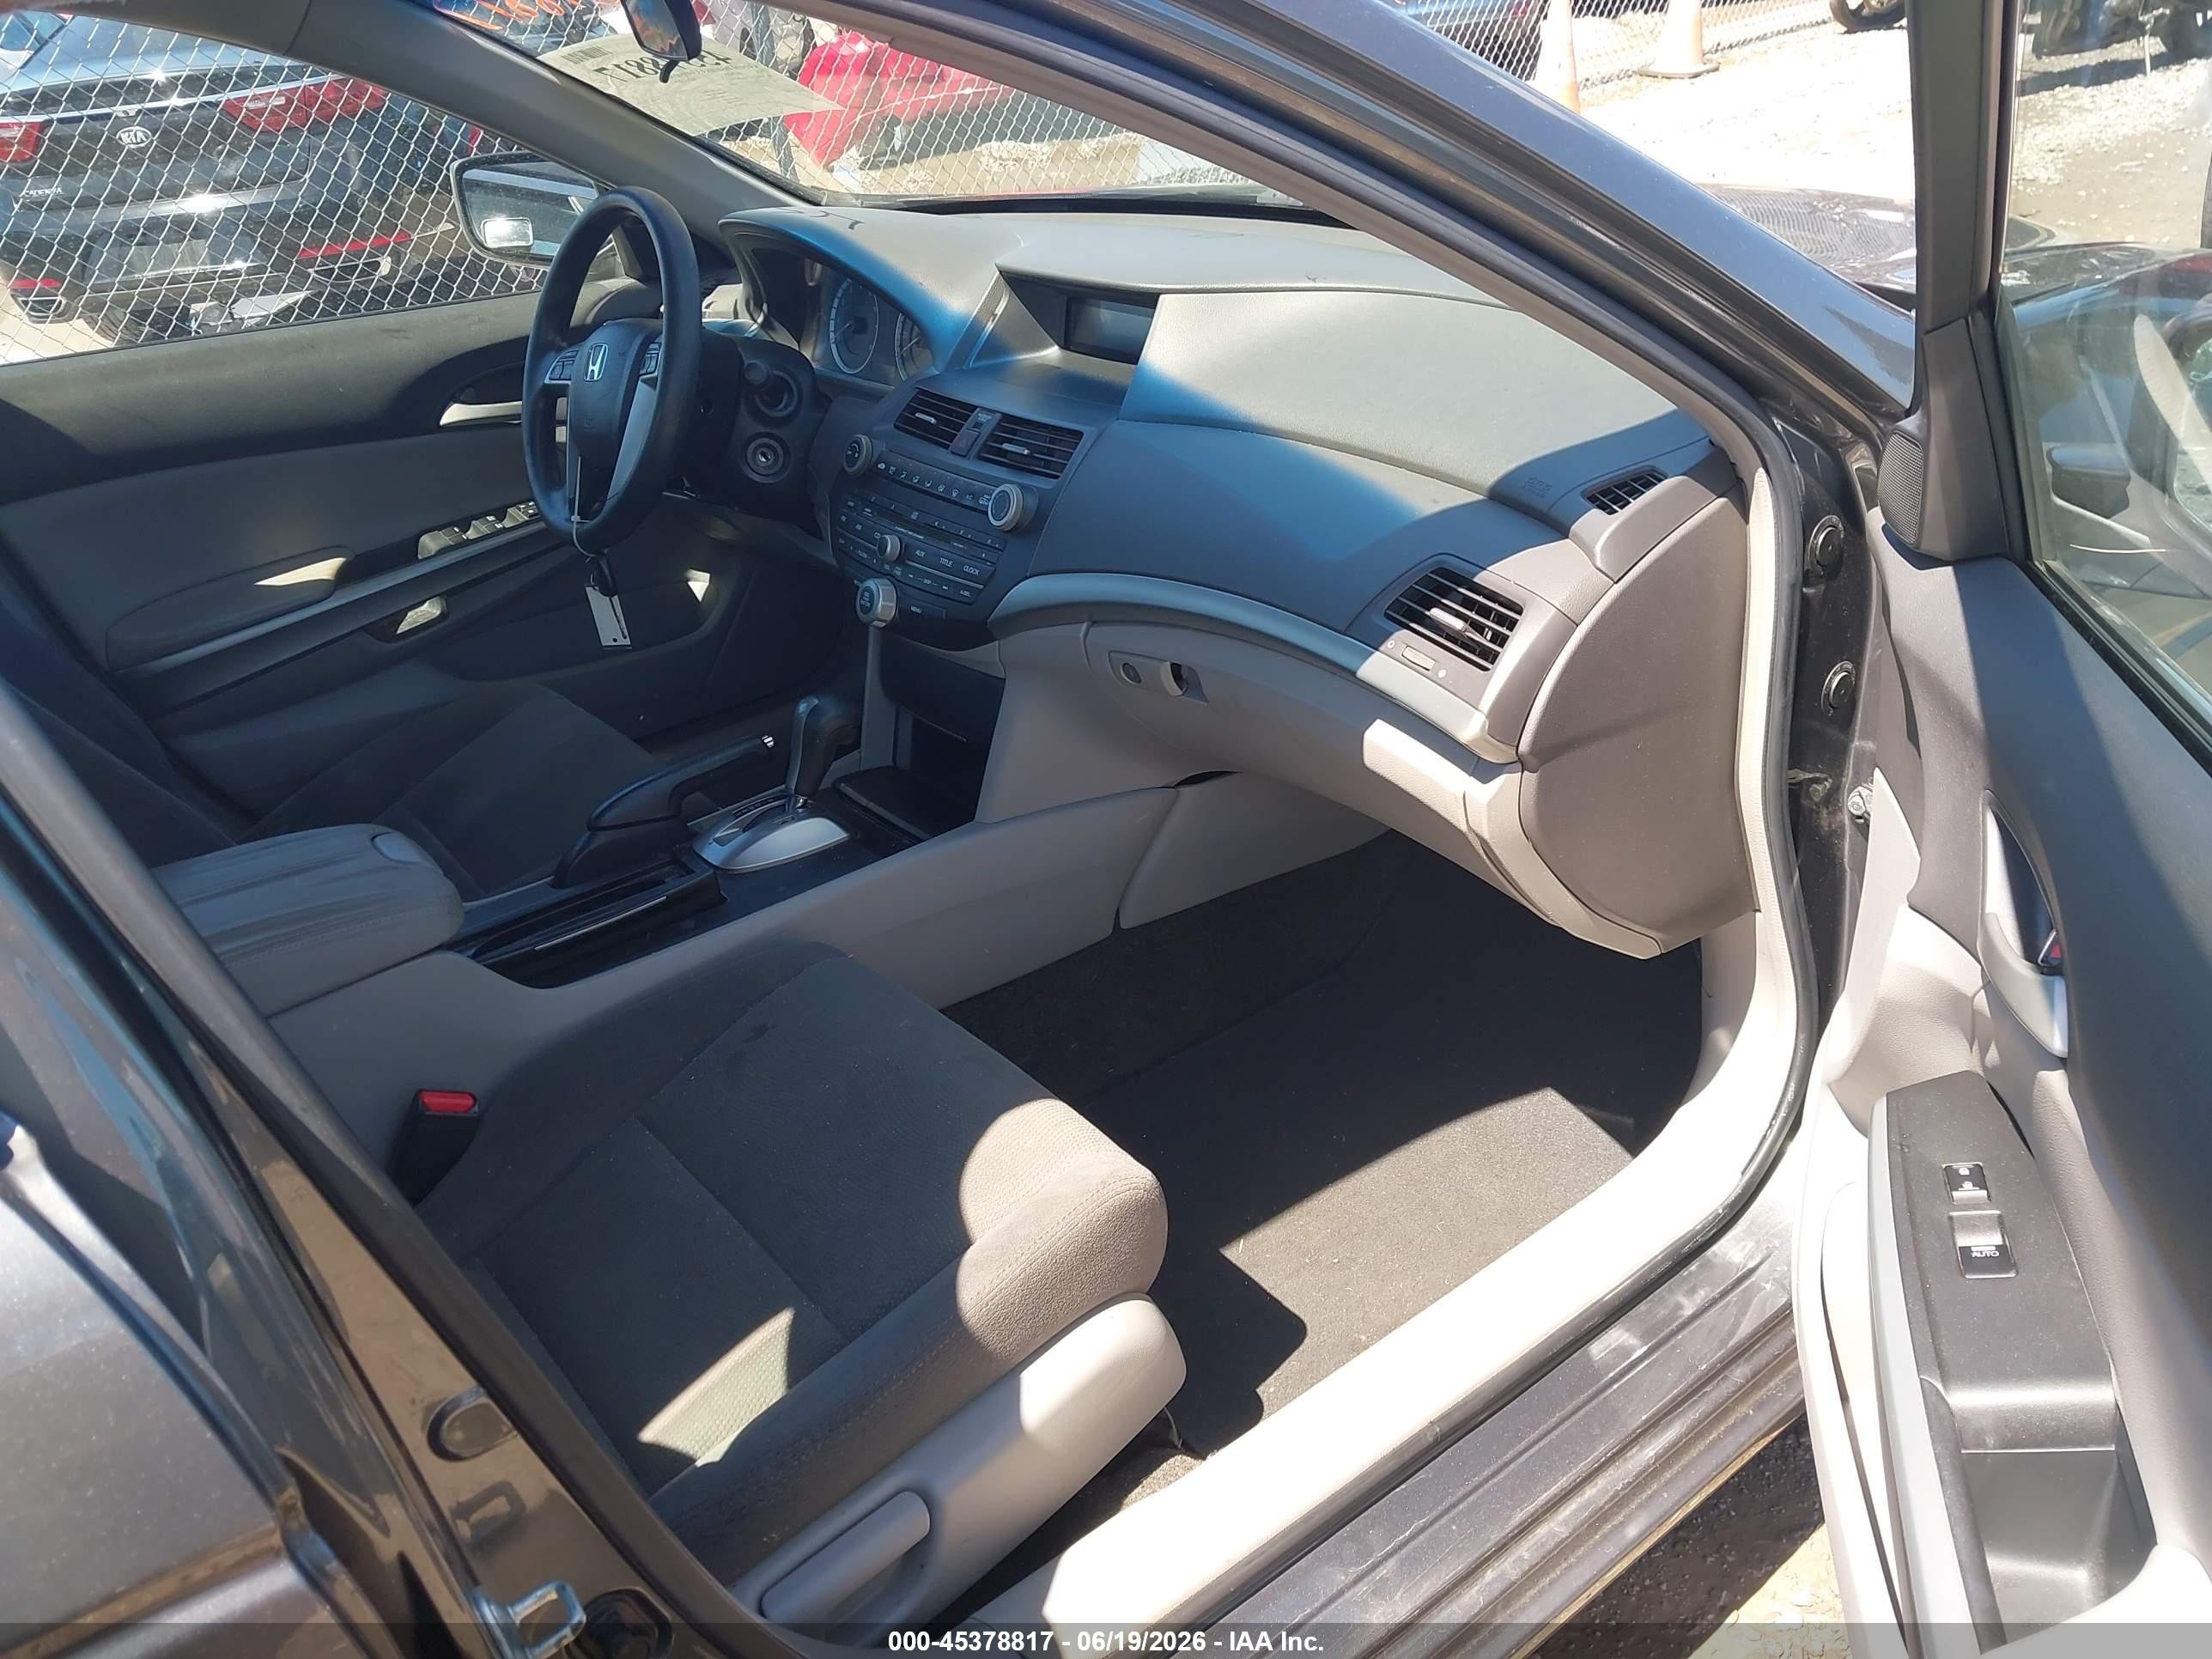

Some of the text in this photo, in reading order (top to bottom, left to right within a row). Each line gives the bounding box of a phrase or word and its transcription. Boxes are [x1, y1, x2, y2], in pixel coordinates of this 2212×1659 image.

[119, 130, 149, 144] KIA
[939, 557, 954, 568] TITLE
[963, 565, 981, 576] CLOCK
